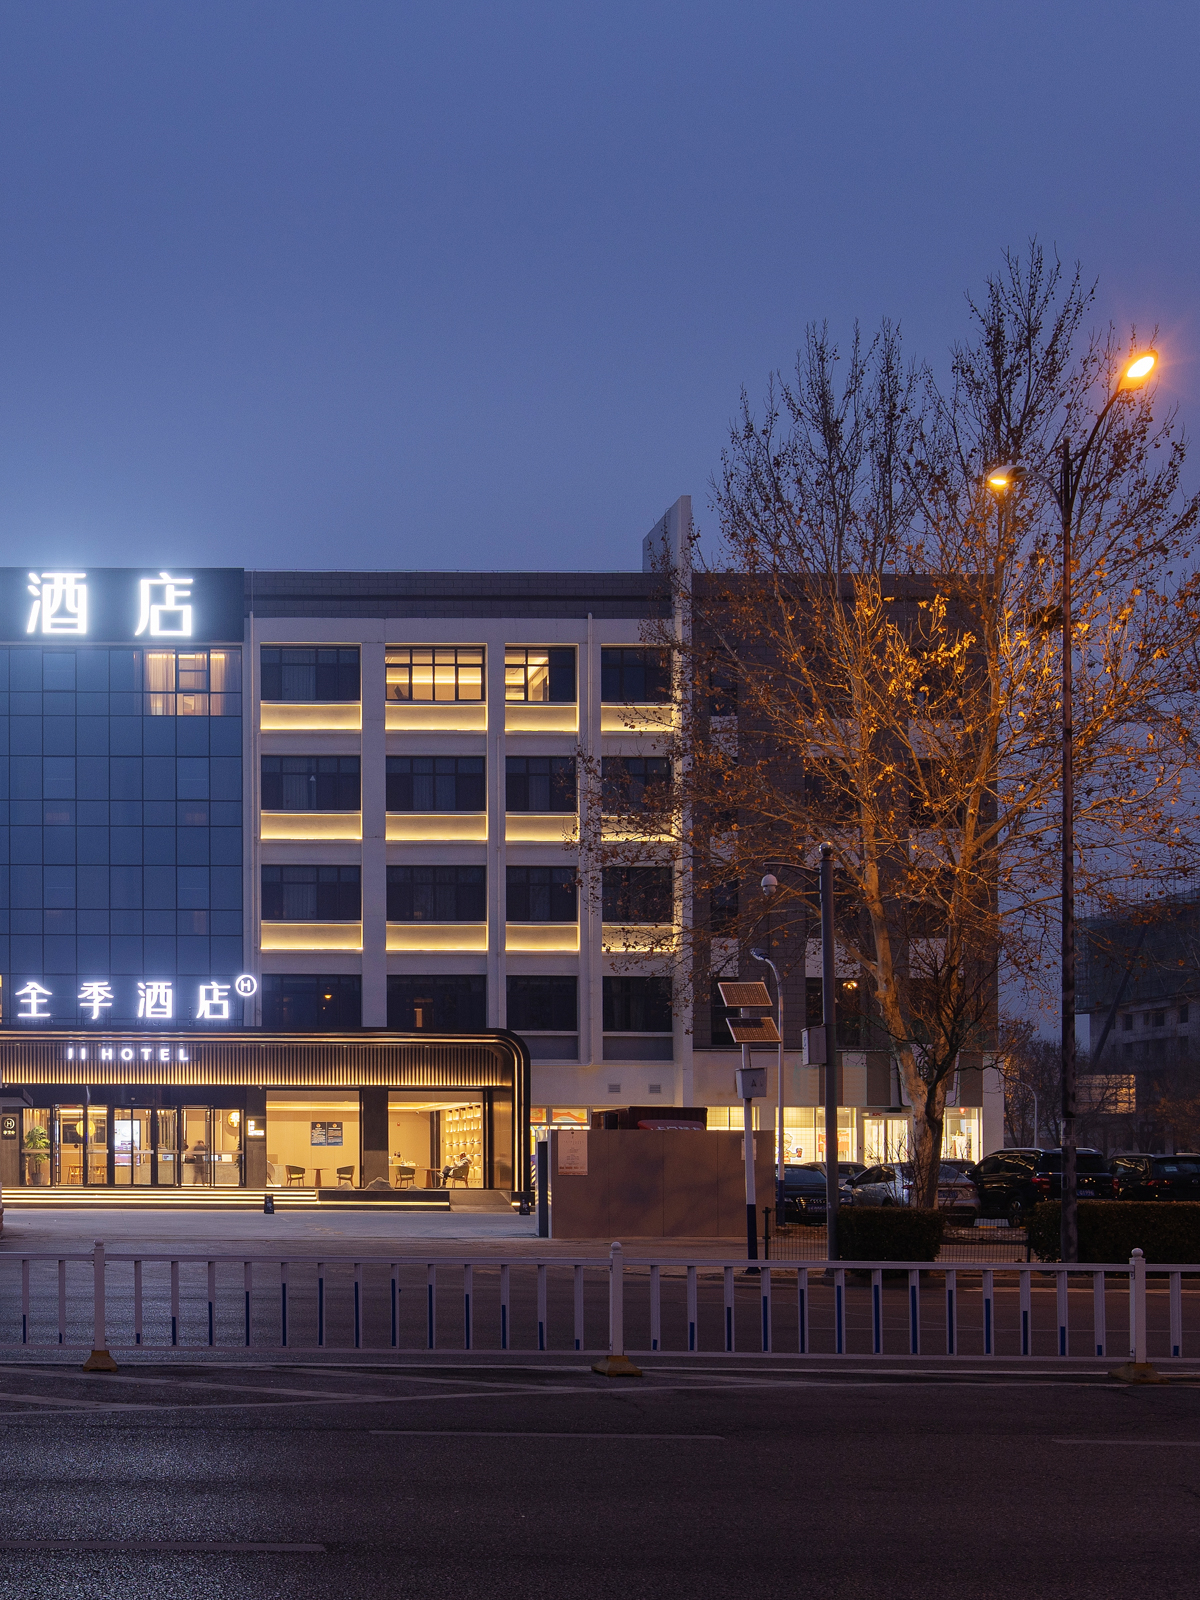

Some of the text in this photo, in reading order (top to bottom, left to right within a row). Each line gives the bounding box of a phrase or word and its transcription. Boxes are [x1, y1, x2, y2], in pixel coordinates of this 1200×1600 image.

[15, 981, 231, 1020] 全季酒店
[68, 1048, 189, 1061] JI HOTEL
